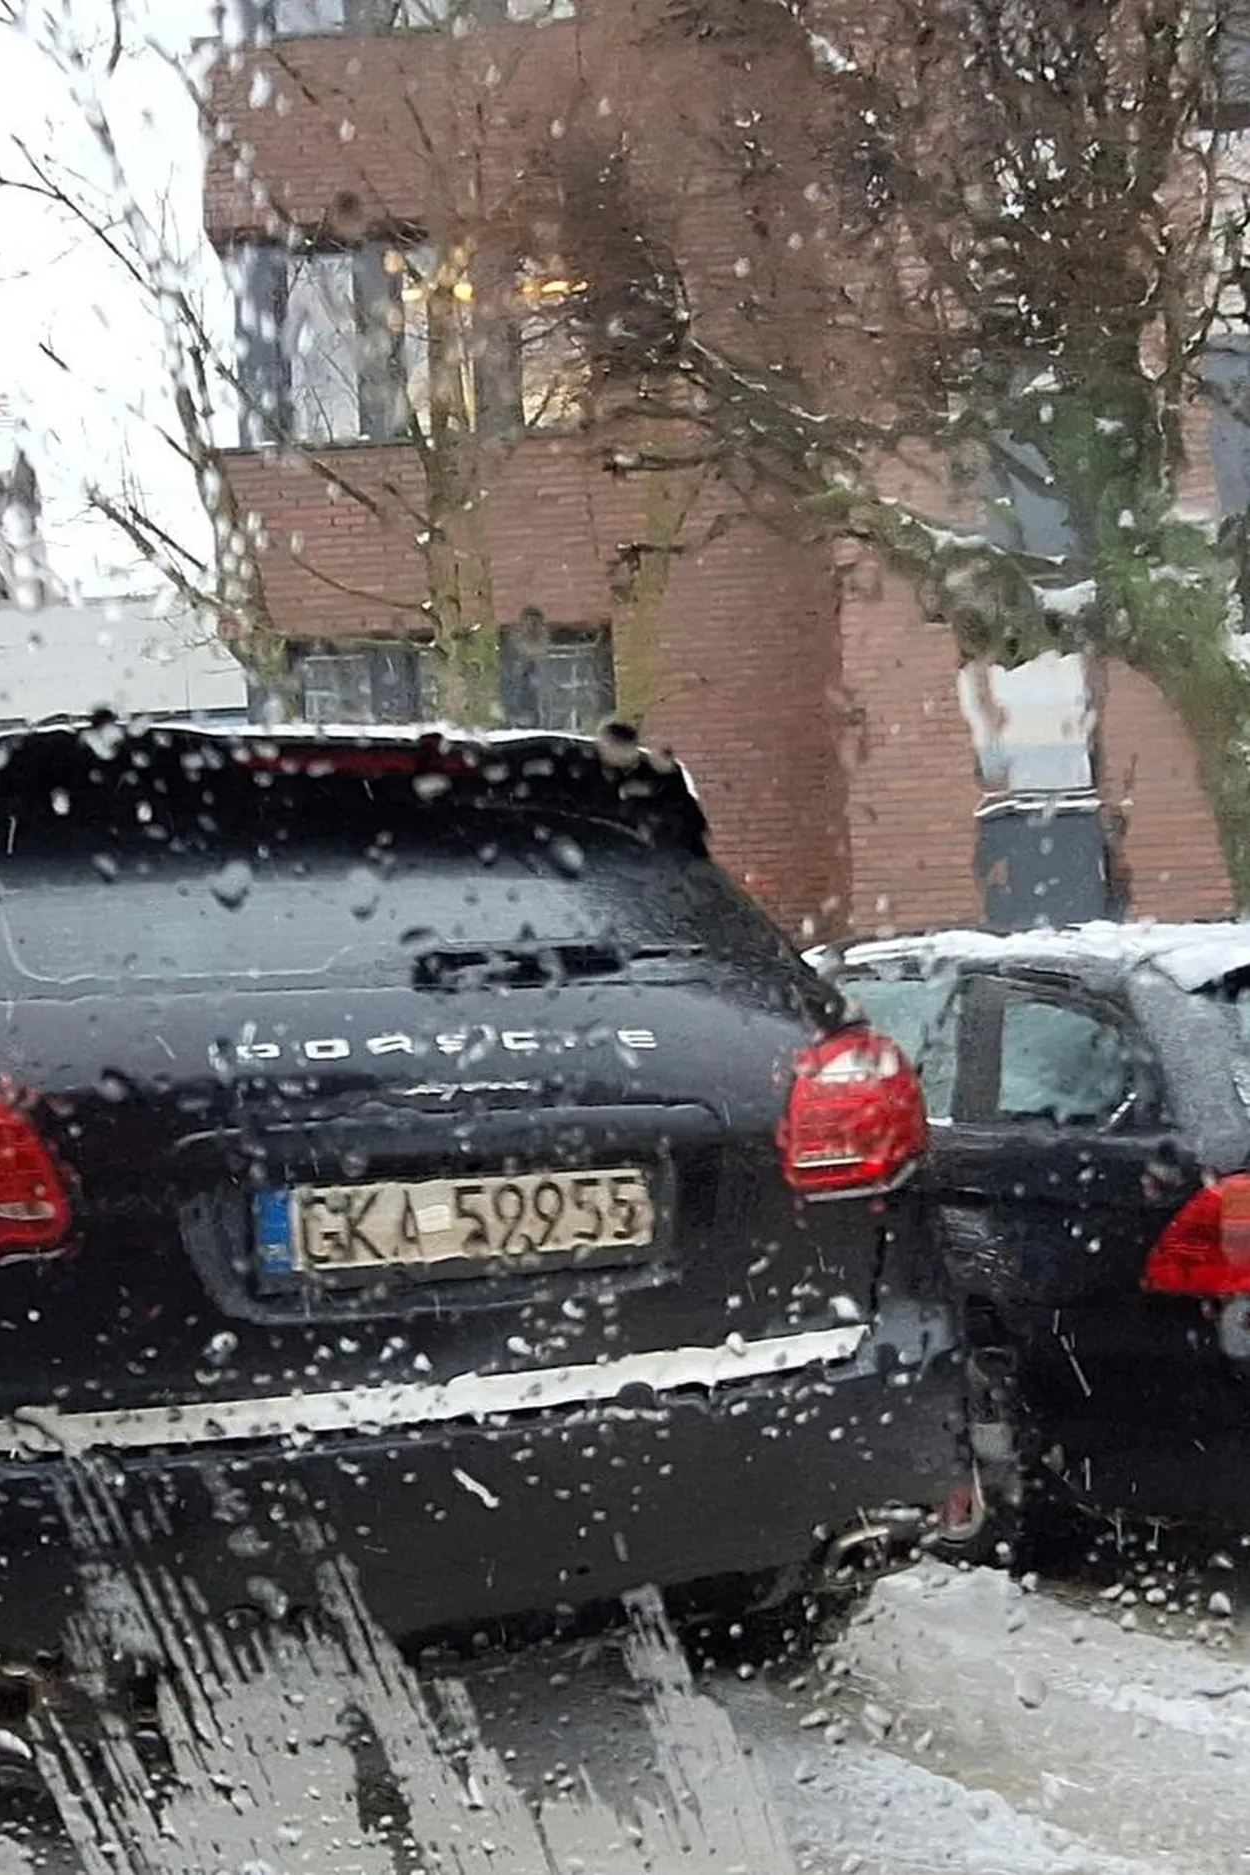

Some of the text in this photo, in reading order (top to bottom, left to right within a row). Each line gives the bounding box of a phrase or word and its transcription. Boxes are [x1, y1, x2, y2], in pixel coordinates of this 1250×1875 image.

[236, 1028, 658, 1061] PORSCE
[302, 1176, 639, 1264] GKA 59955
